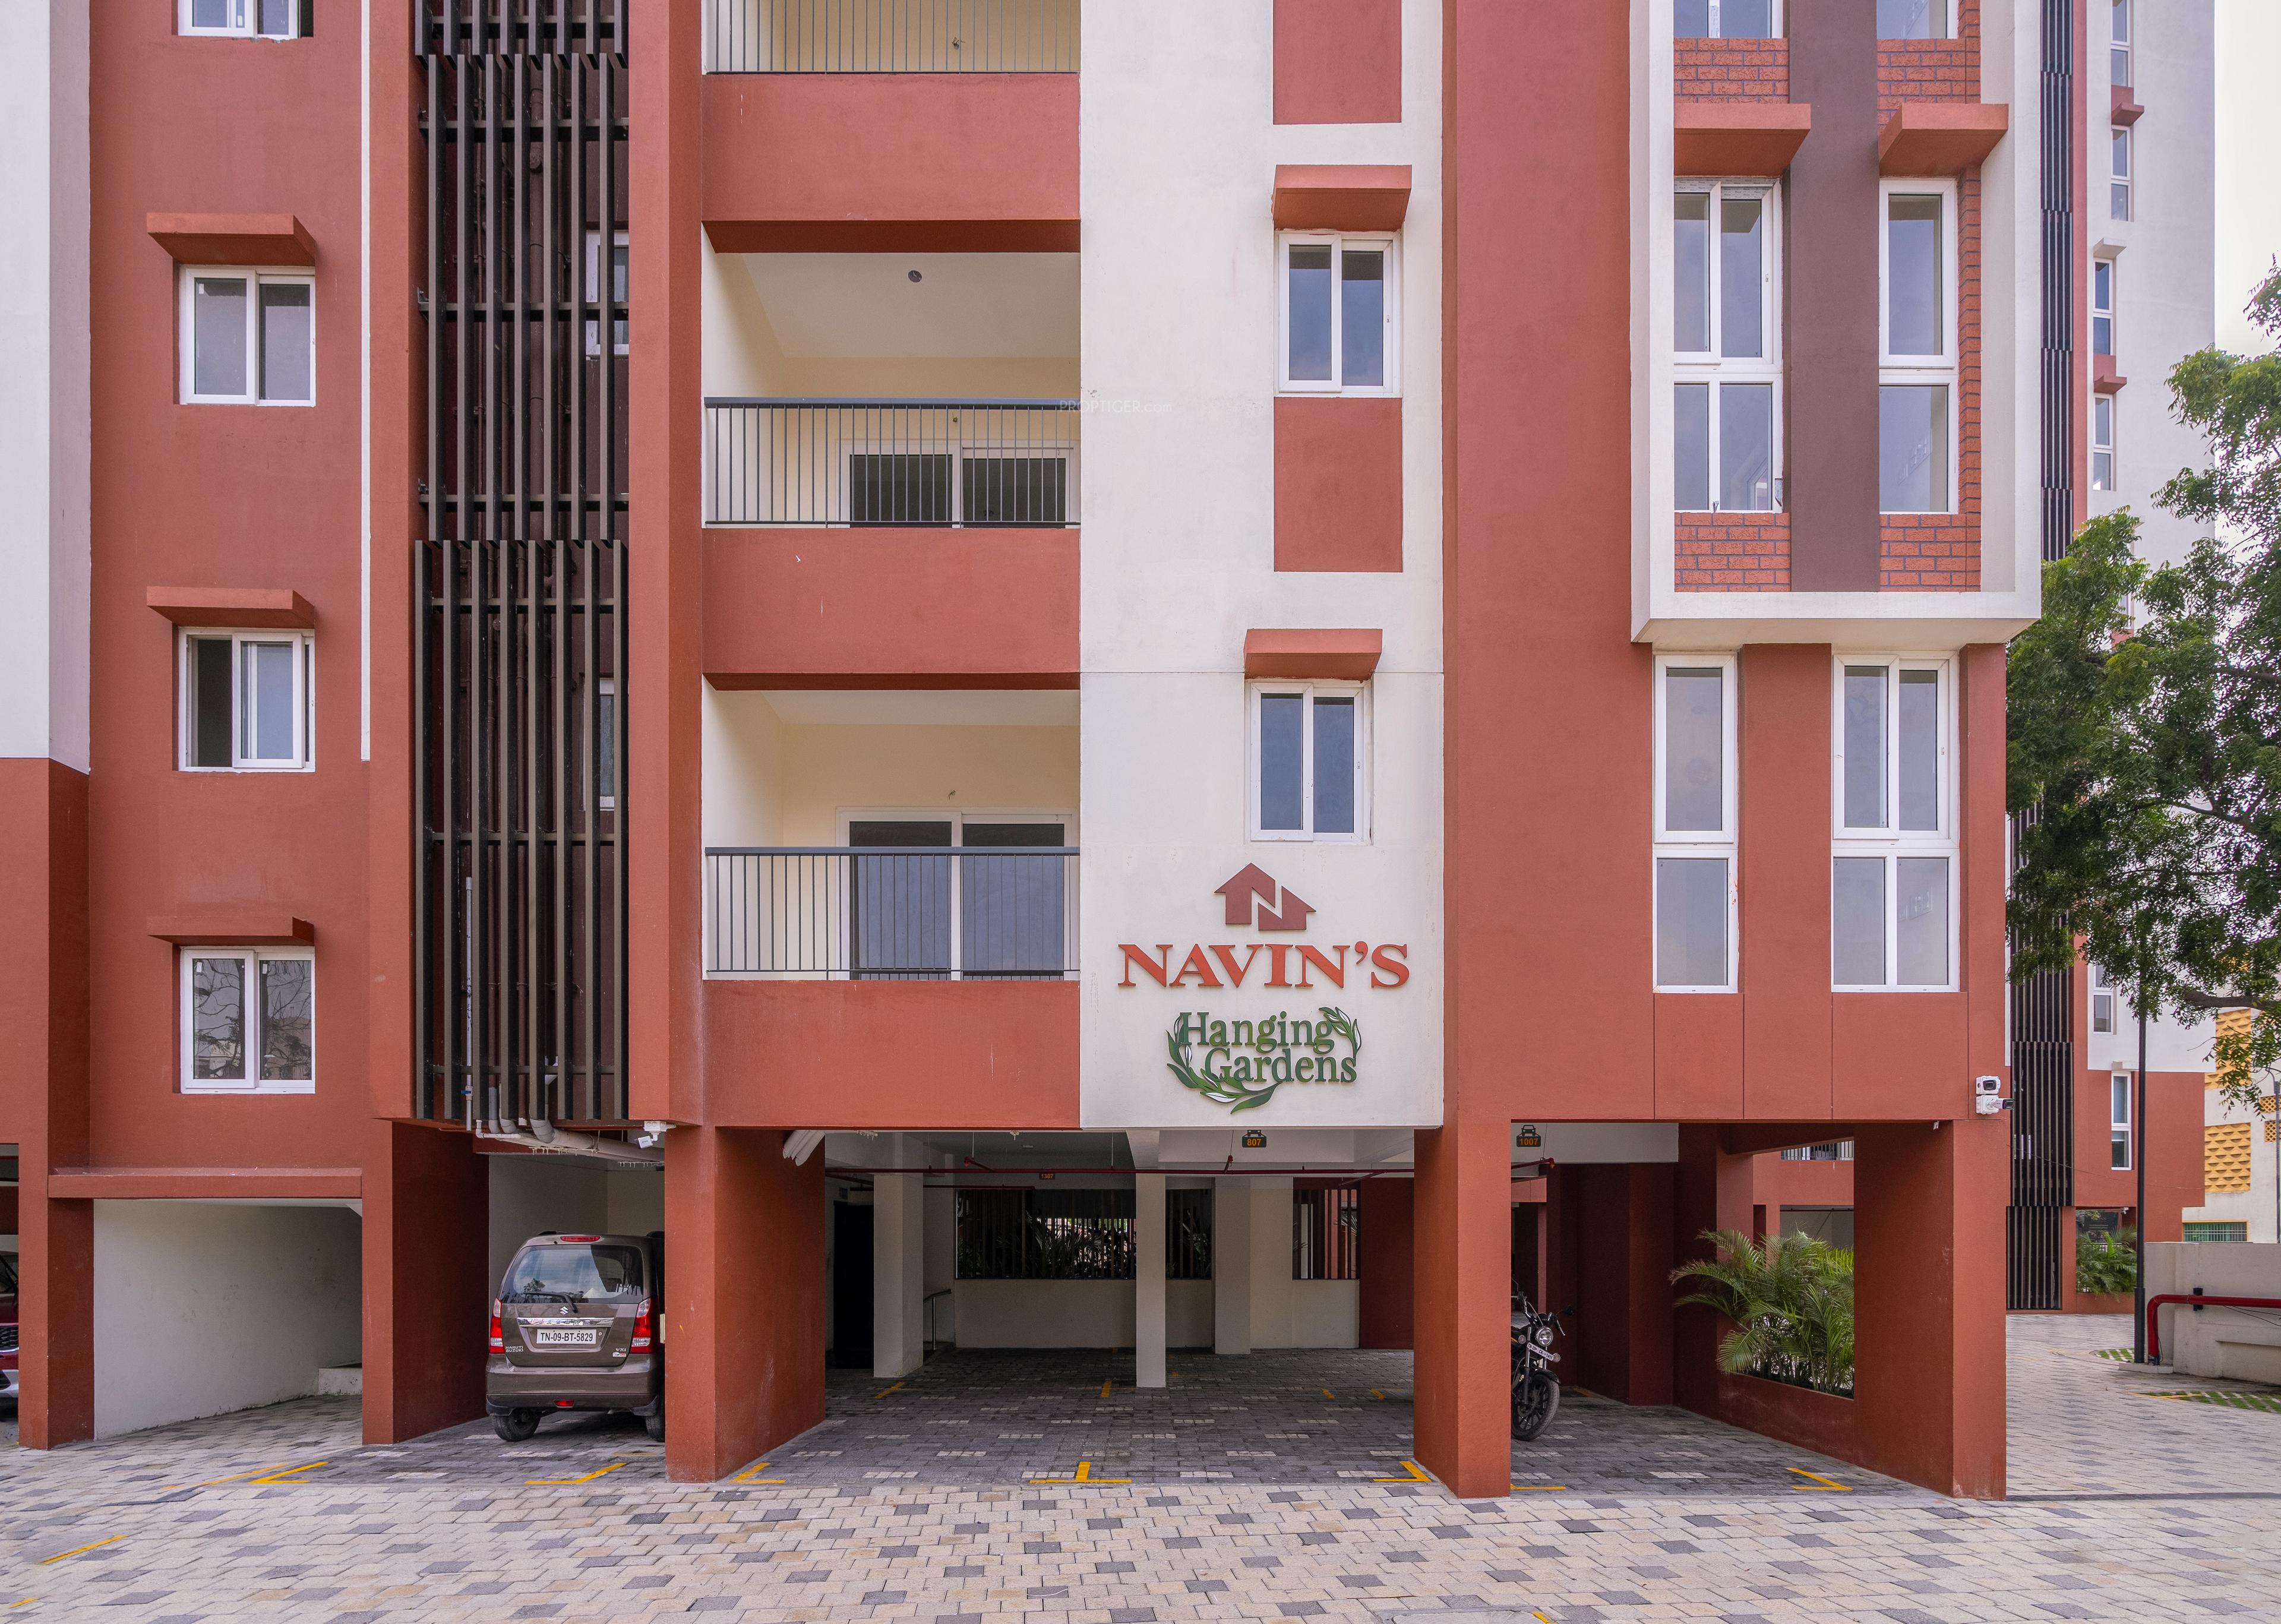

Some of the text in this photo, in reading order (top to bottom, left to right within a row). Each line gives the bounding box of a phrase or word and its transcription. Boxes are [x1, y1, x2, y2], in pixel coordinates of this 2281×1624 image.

[1117, 941, 1410, 988] NAVIN'S
[1179, 1010, 1335, 1054] Hanging
[1203, 1048, 1357, 1083] Gardens
[540, 1331, 593, 1342] TN-09-BT-5829
